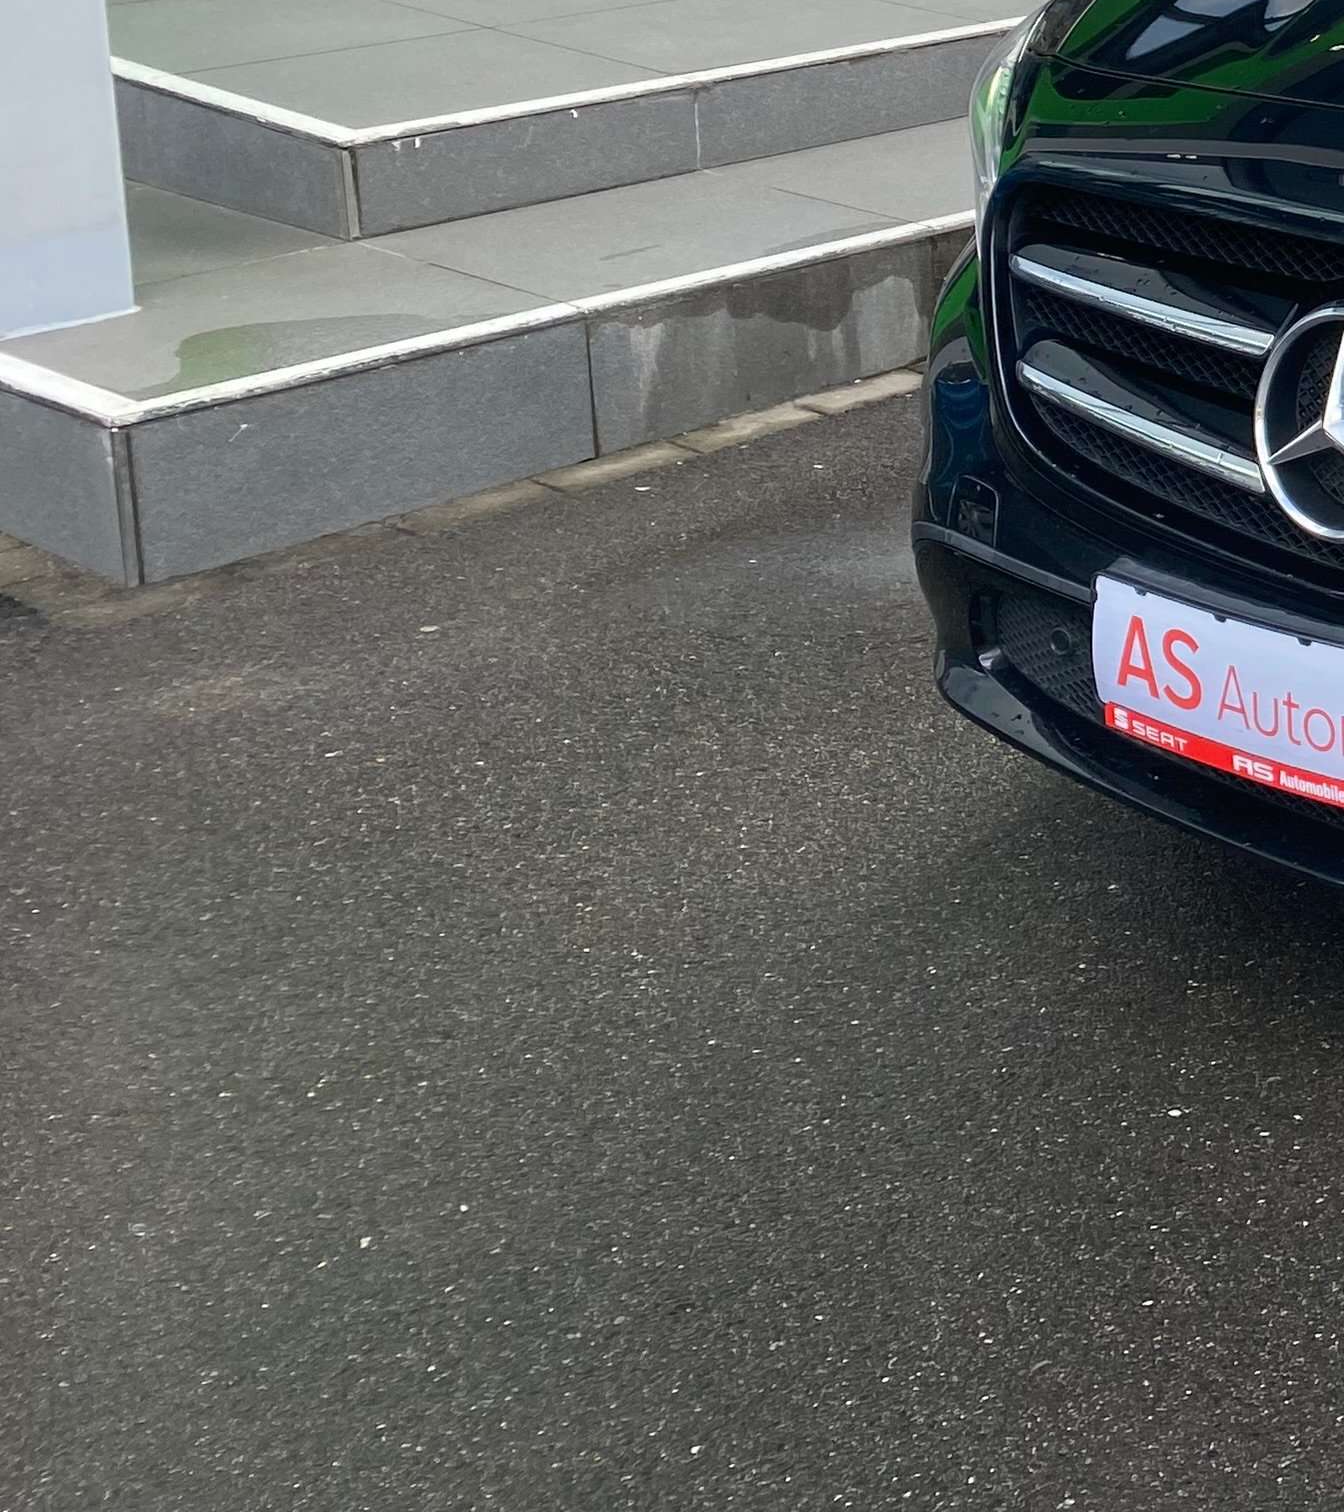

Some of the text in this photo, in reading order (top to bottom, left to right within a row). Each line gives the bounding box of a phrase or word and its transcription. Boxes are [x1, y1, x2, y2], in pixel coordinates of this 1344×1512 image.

[1116, 615, 1202, 710] AS
[1132, 719, 1188, 751] SEAT
[1232, 754, 1275, 782] AS
